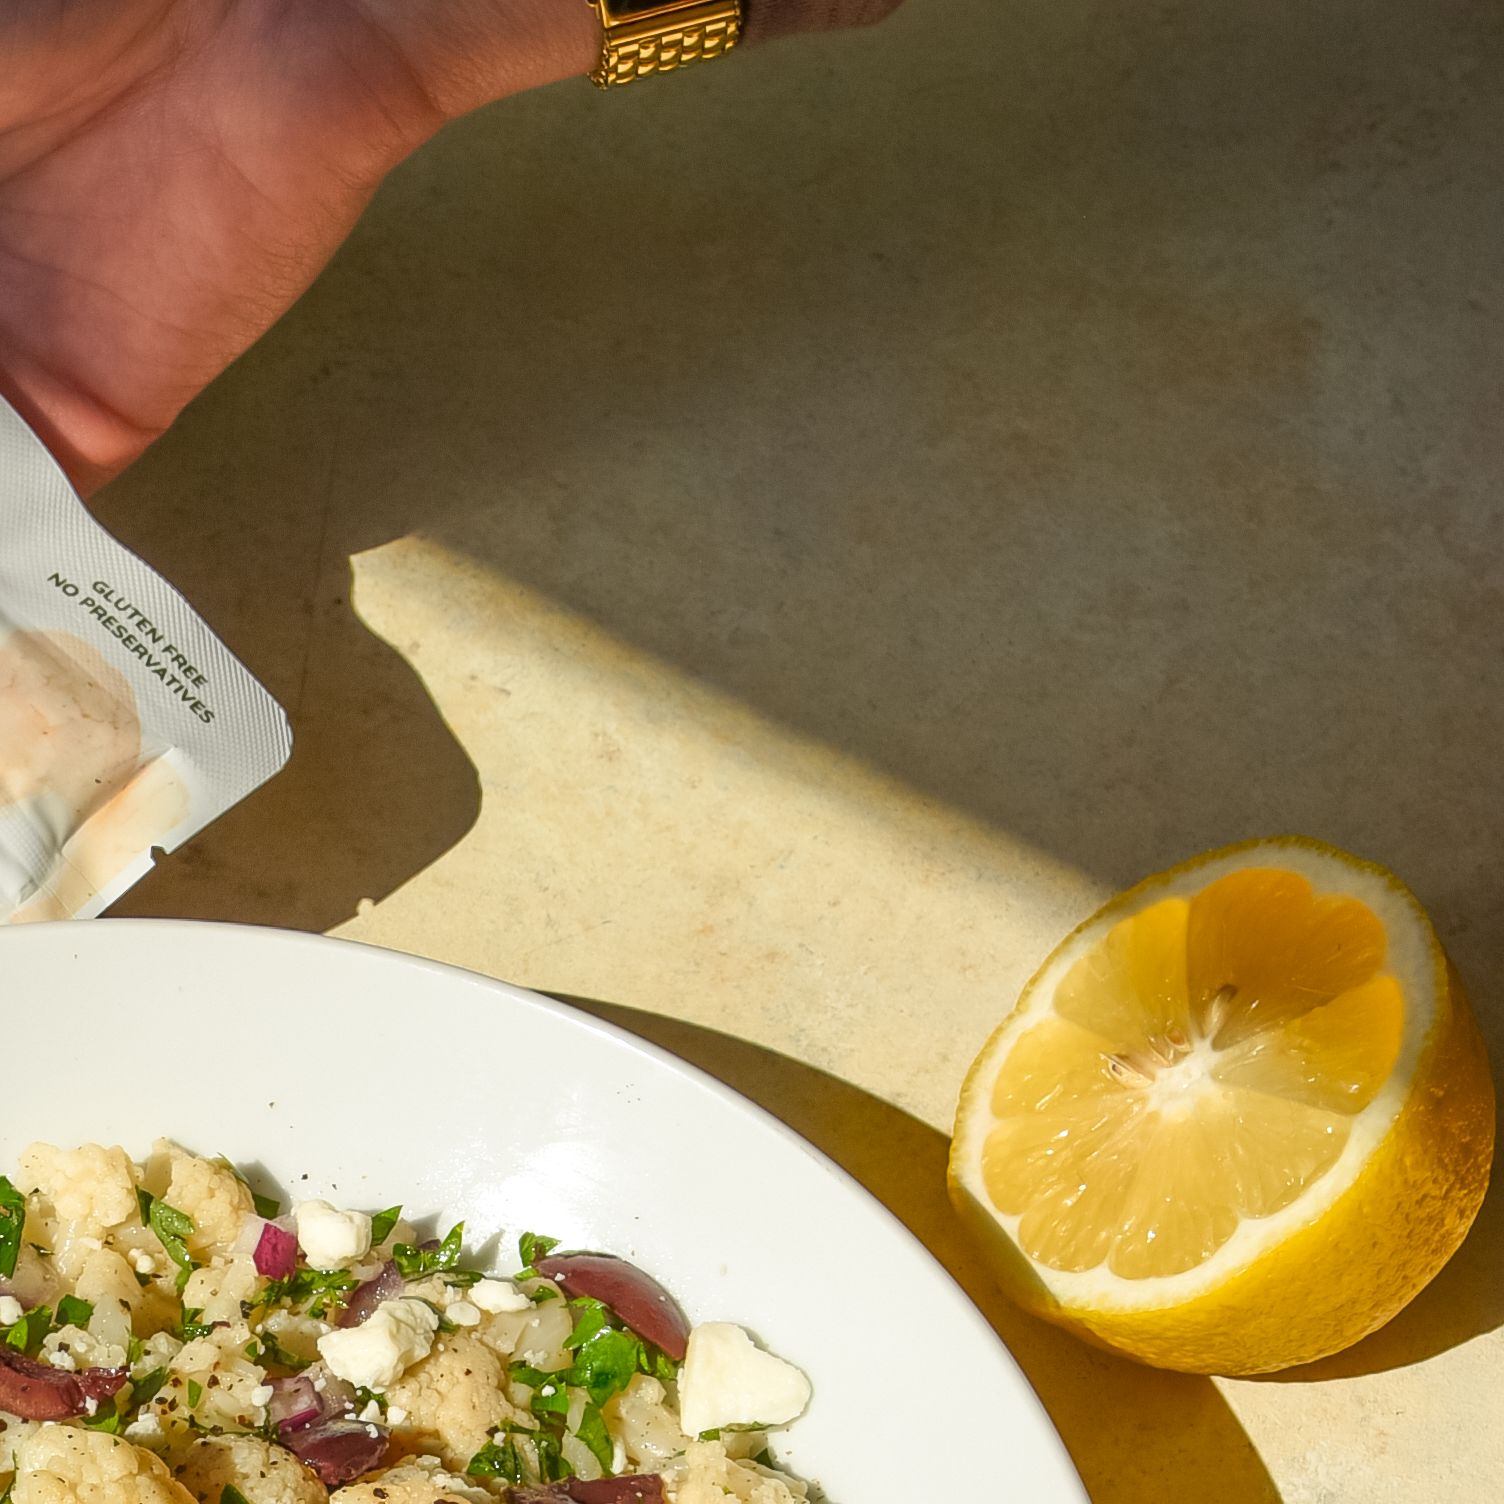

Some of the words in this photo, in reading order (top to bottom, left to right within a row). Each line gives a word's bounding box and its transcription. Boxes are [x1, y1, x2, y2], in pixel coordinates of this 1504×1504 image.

[47, 572, 79, 597] NO
[79, 597, 215, 723] PRESERVATIVES
[92, 580, 164, 644] GLUTEN
[161, 644, 208, 689] FREE
